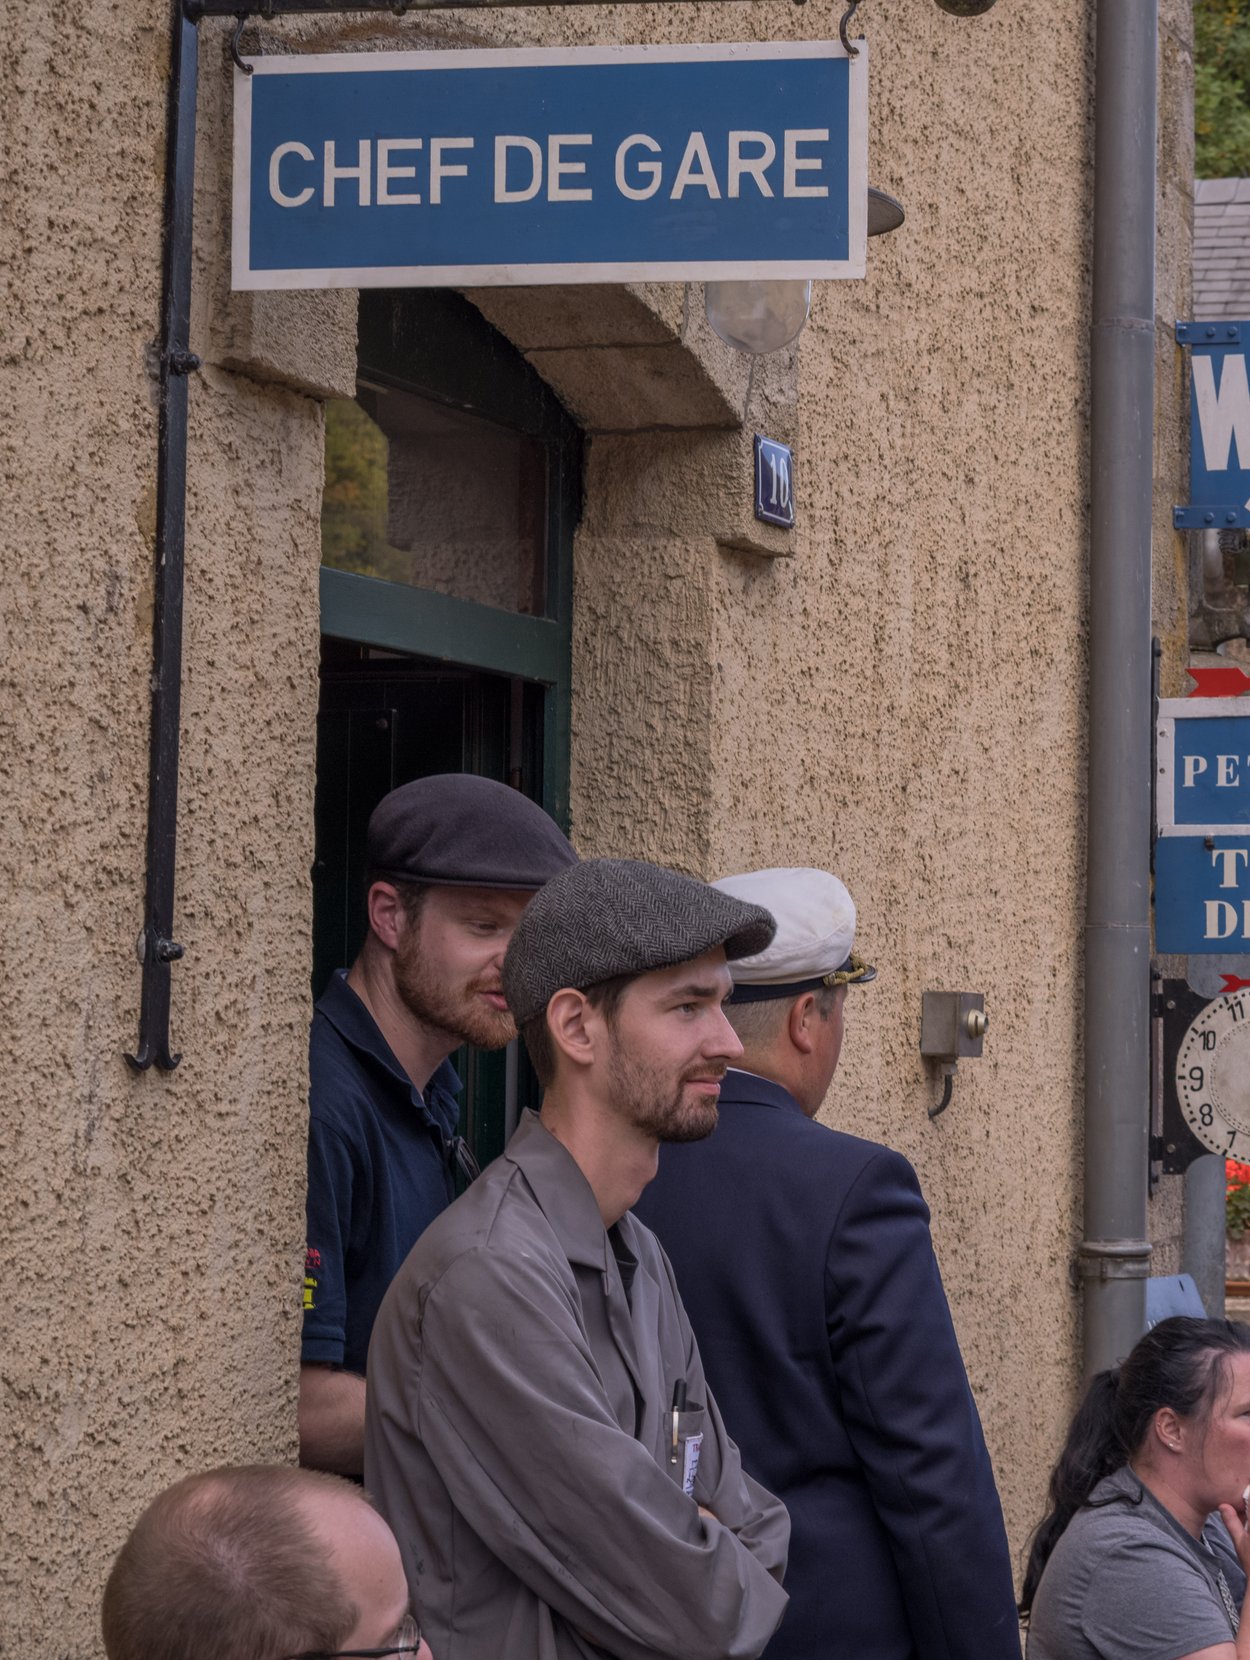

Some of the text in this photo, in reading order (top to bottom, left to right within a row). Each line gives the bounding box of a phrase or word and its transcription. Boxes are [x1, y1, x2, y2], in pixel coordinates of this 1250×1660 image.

[268, 128, 829, 208] CHEF DE GARE
[769, 453, 790, 509] 10
[1227, 1000, 1245, 1022] 11
[1198, 1030, 1216, 1050] 10
[1188, 1066, 1204, 1091] 9
[1199, 1103, 1214, 1126] 8
[1226, 1130, 1237, 1149] 7
